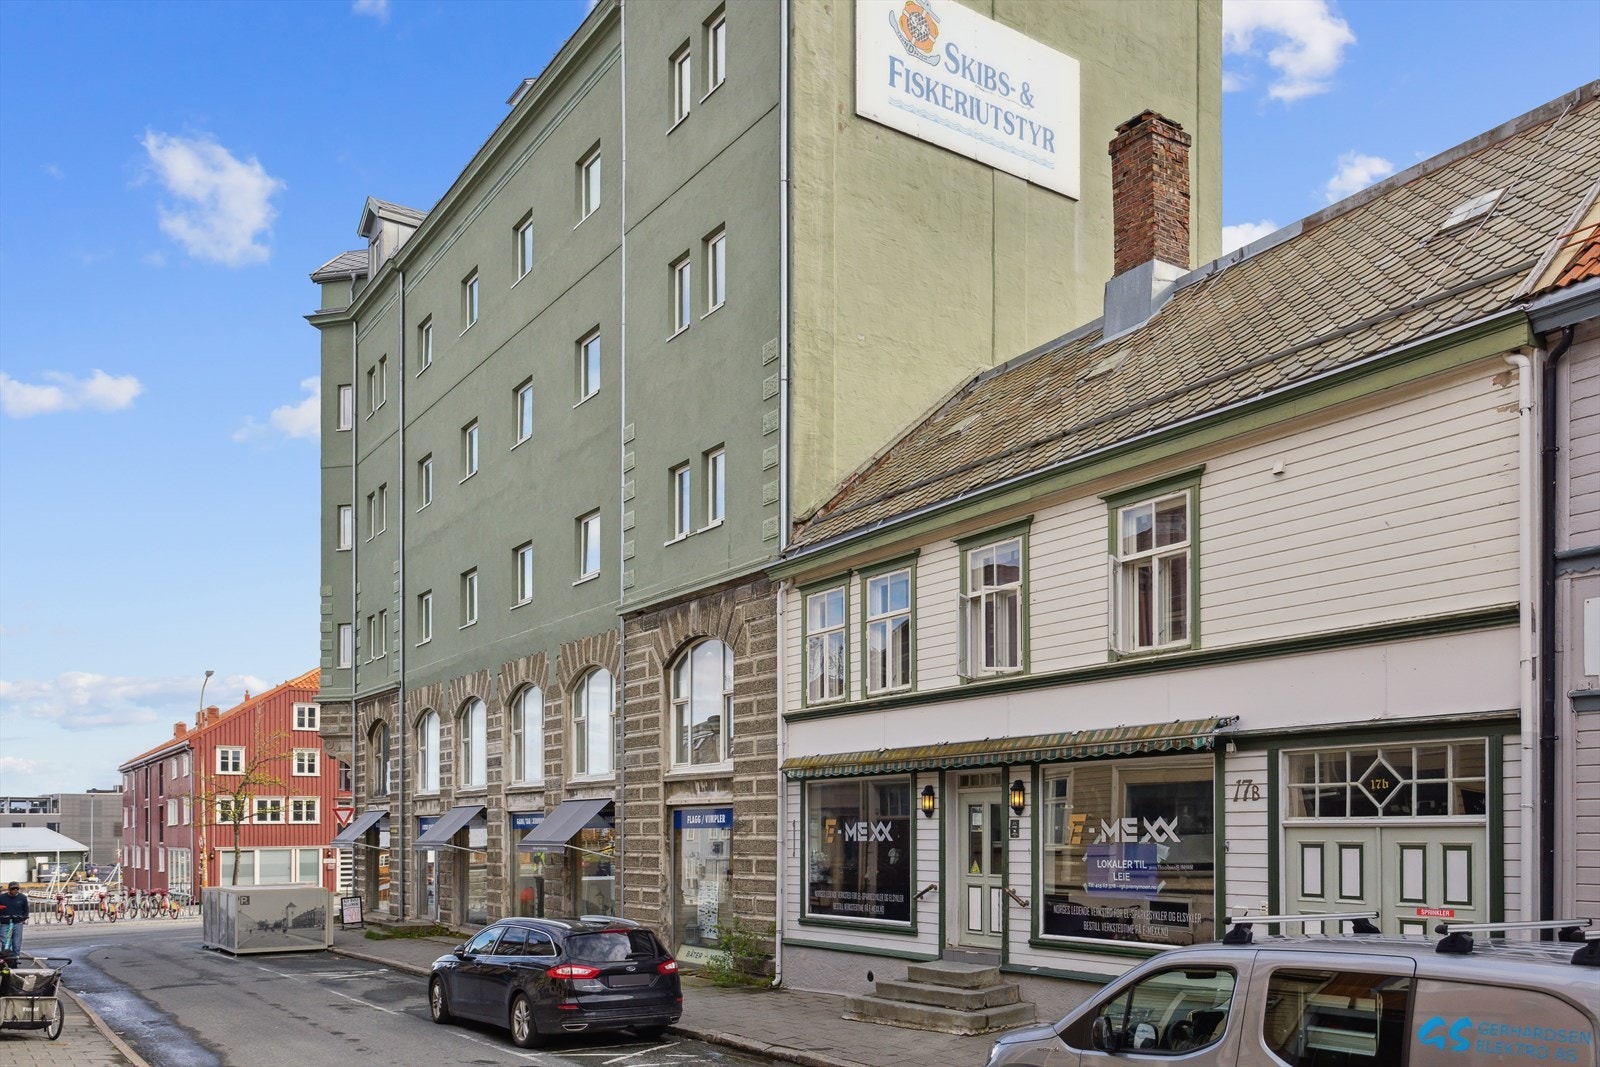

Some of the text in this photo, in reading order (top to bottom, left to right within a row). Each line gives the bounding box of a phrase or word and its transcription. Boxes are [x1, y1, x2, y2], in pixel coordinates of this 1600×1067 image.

[944, 42, 1015, 97] SKIBS-
[1020, 81, 1035, 109] &
[888, 55, 1055, 154] FISKERIUTSTYR
[1233, 779, 1261, 802] 17B
[1371, 778, 1389, 790] 17b
[686, 815, 701, 824] FLAGG
[705, 814, 726, 823] VIMPLER
[1096, 859, 1133, 869] LOKALER
[1134, 860, 1147, 869] TIL
[1113, 872, 1130, 881] LEIE
[1053, 905, 1070, 915] NORGES
[1070, 906, 1090, 916] LEDENDE
[1168, 911, 1176, 921] OG
[1176, 911, 1202, 923] ELSYKLER
[1420, 909, 1450, 917] SPRINKLER
[1083, 920, 1100, 931] BESTILL
[1477, 1021, 1591, 1046] GERHARDSEN
[1475, 1039, 1578, 1063] ELEKTRO AS
